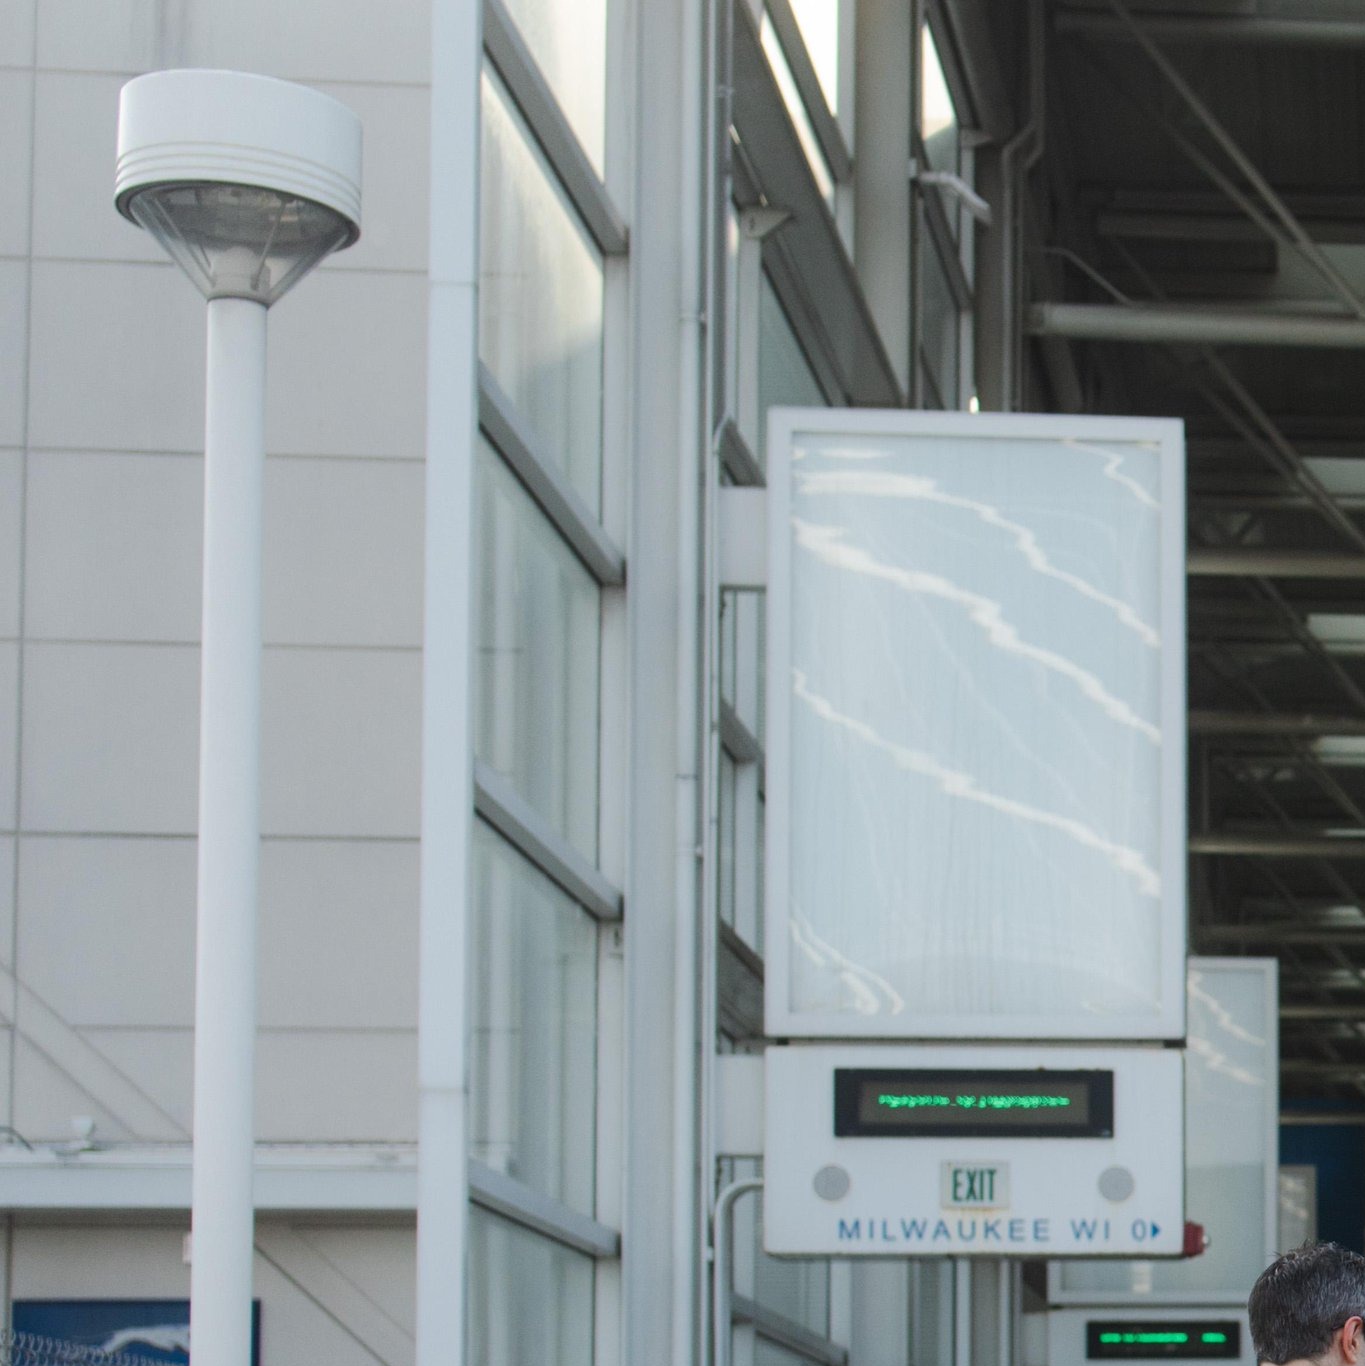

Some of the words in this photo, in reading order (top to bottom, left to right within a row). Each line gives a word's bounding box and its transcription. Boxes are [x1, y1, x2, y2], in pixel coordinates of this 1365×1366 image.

[951, 1168, 997, 1202] EXIT
[838, 1217, 1050, 1242] MILWAUKEE
[1071, 1218, 1111, 1242] WI
